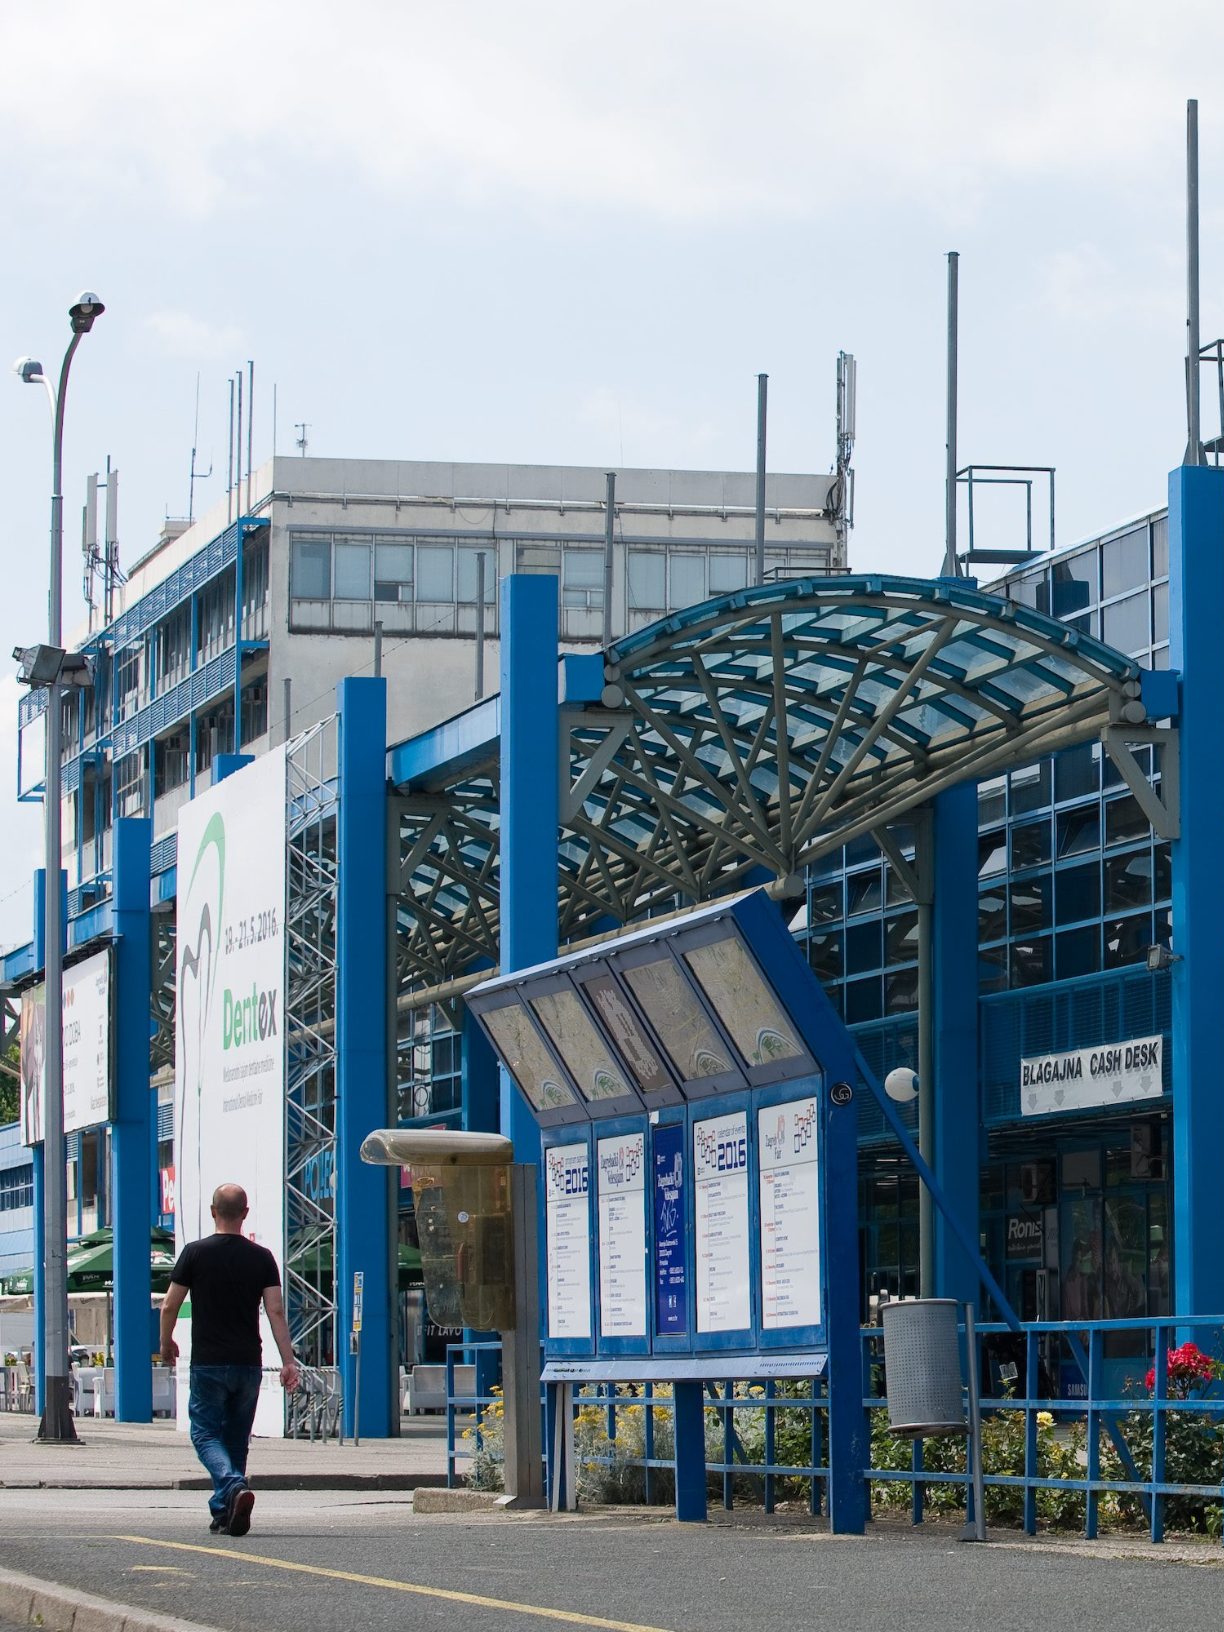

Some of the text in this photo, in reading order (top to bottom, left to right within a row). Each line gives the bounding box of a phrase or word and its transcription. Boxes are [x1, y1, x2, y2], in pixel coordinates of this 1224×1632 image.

[223, 982, 278, 1051] Dentex
[1022, 1041, 1159, 1087] BLAGAJNA CASH DESK
[717, 1138, 747, 1171] 2016
[162, 1168, 175, 1213] Pe
[565, 1166, 589, 1194] 2016
[1067, 1383, 1088, 1397] SAMSU
